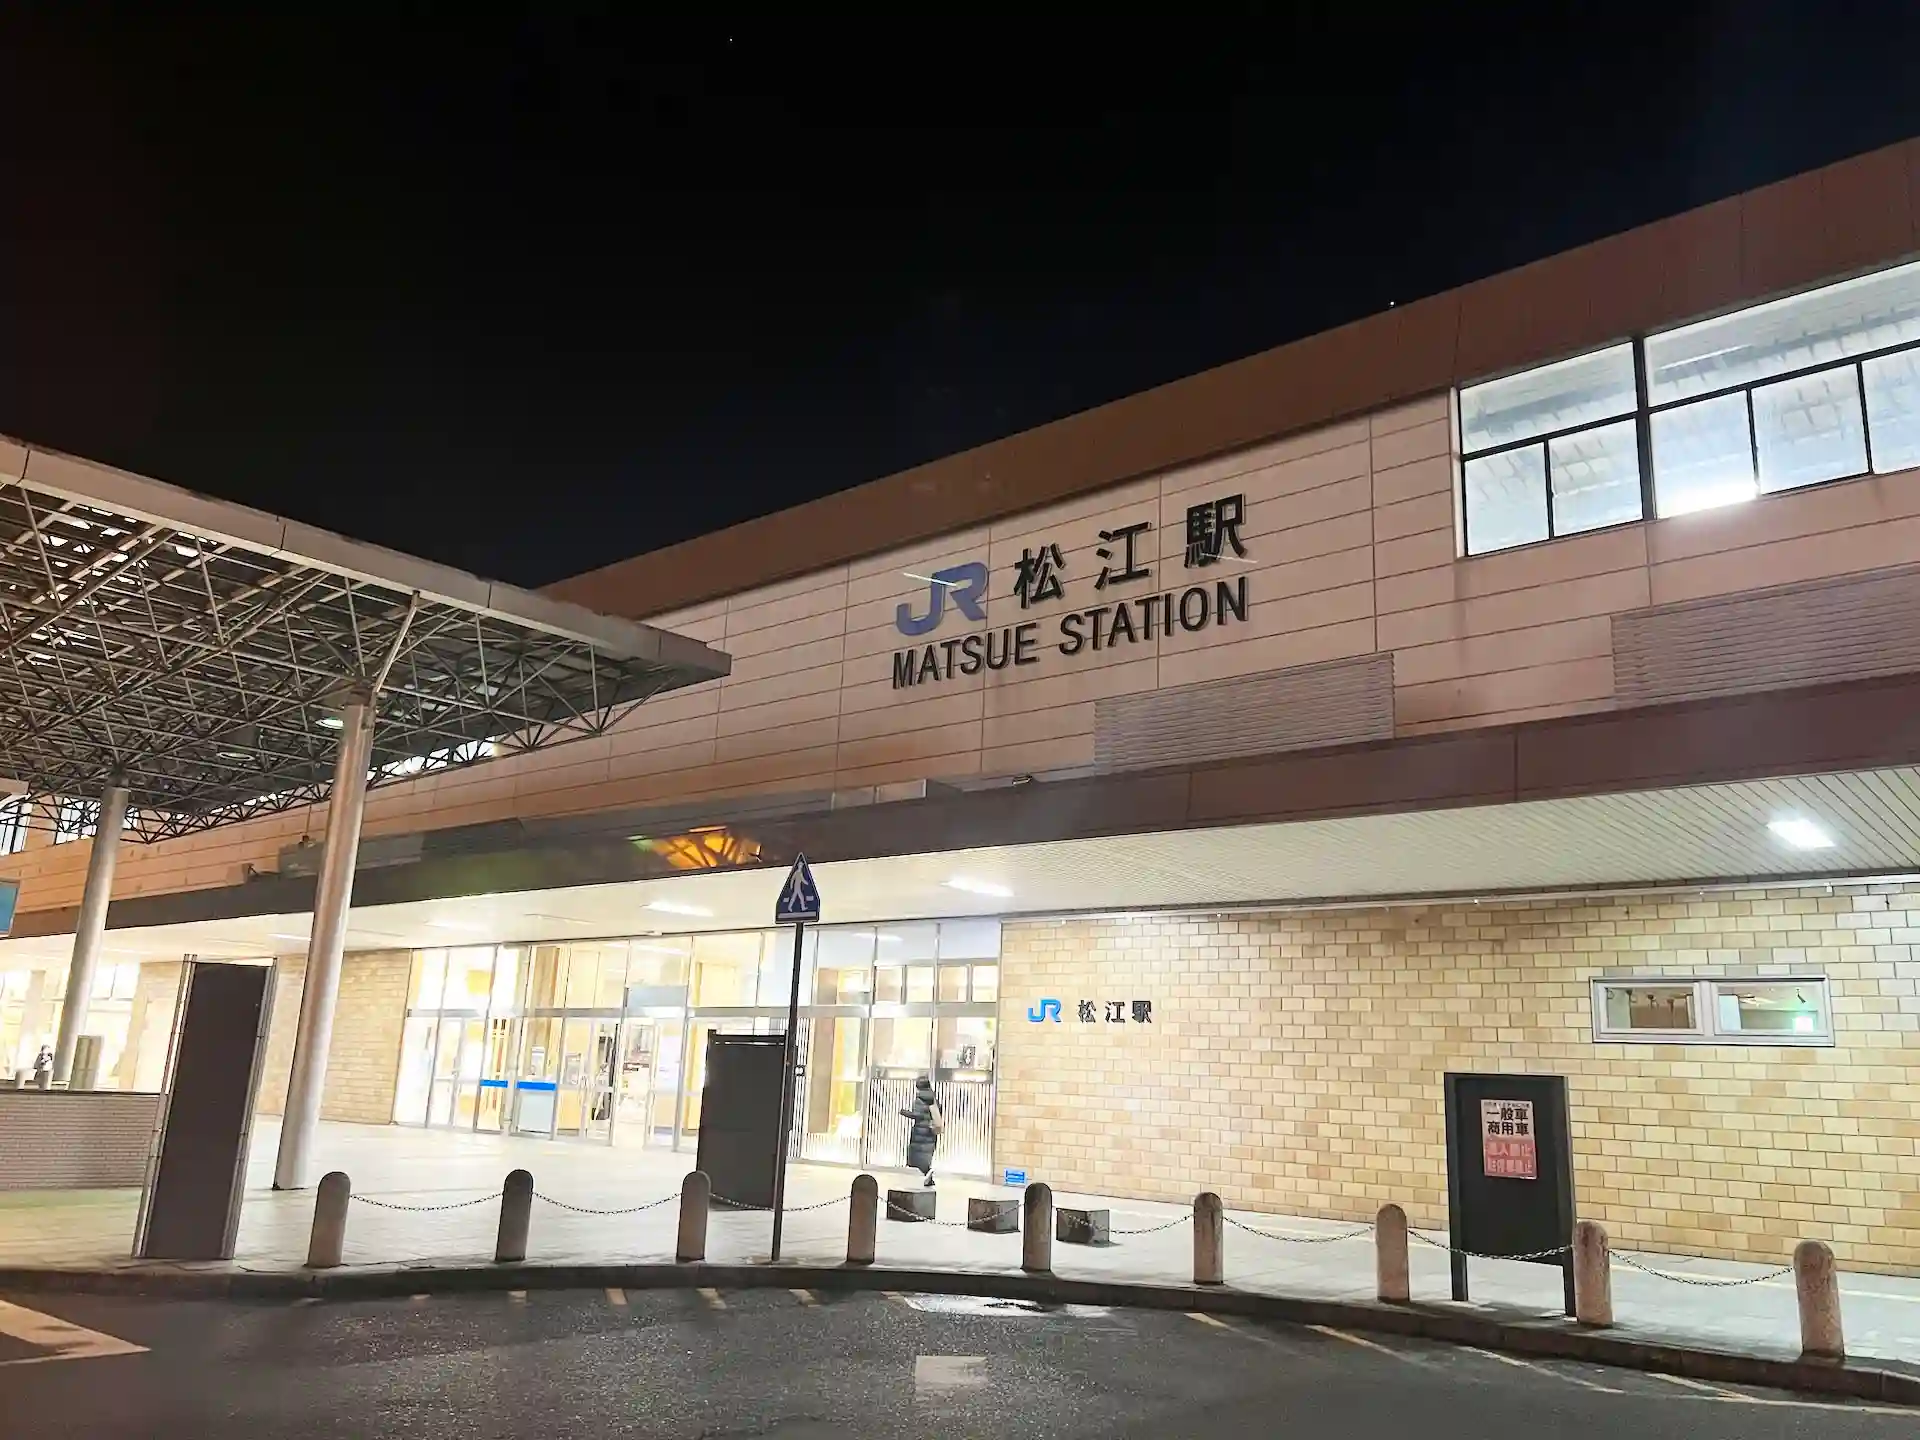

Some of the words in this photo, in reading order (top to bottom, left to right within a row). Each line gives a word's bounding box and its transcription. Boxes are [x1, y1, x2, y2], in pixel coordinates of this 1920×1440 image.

[895, 561, 989, 636] JR
[1013, 493, 1246, 609] 松江駅
[892, 622, 1040, 689] MATSUE
[1058, 576, 1249, 655] STATION
[1027, 998, 1061, 1022] JR
[1077, 1000, 1152, 1023] 松江駅
[1486, 1107, 1529, 1121] 一般車
